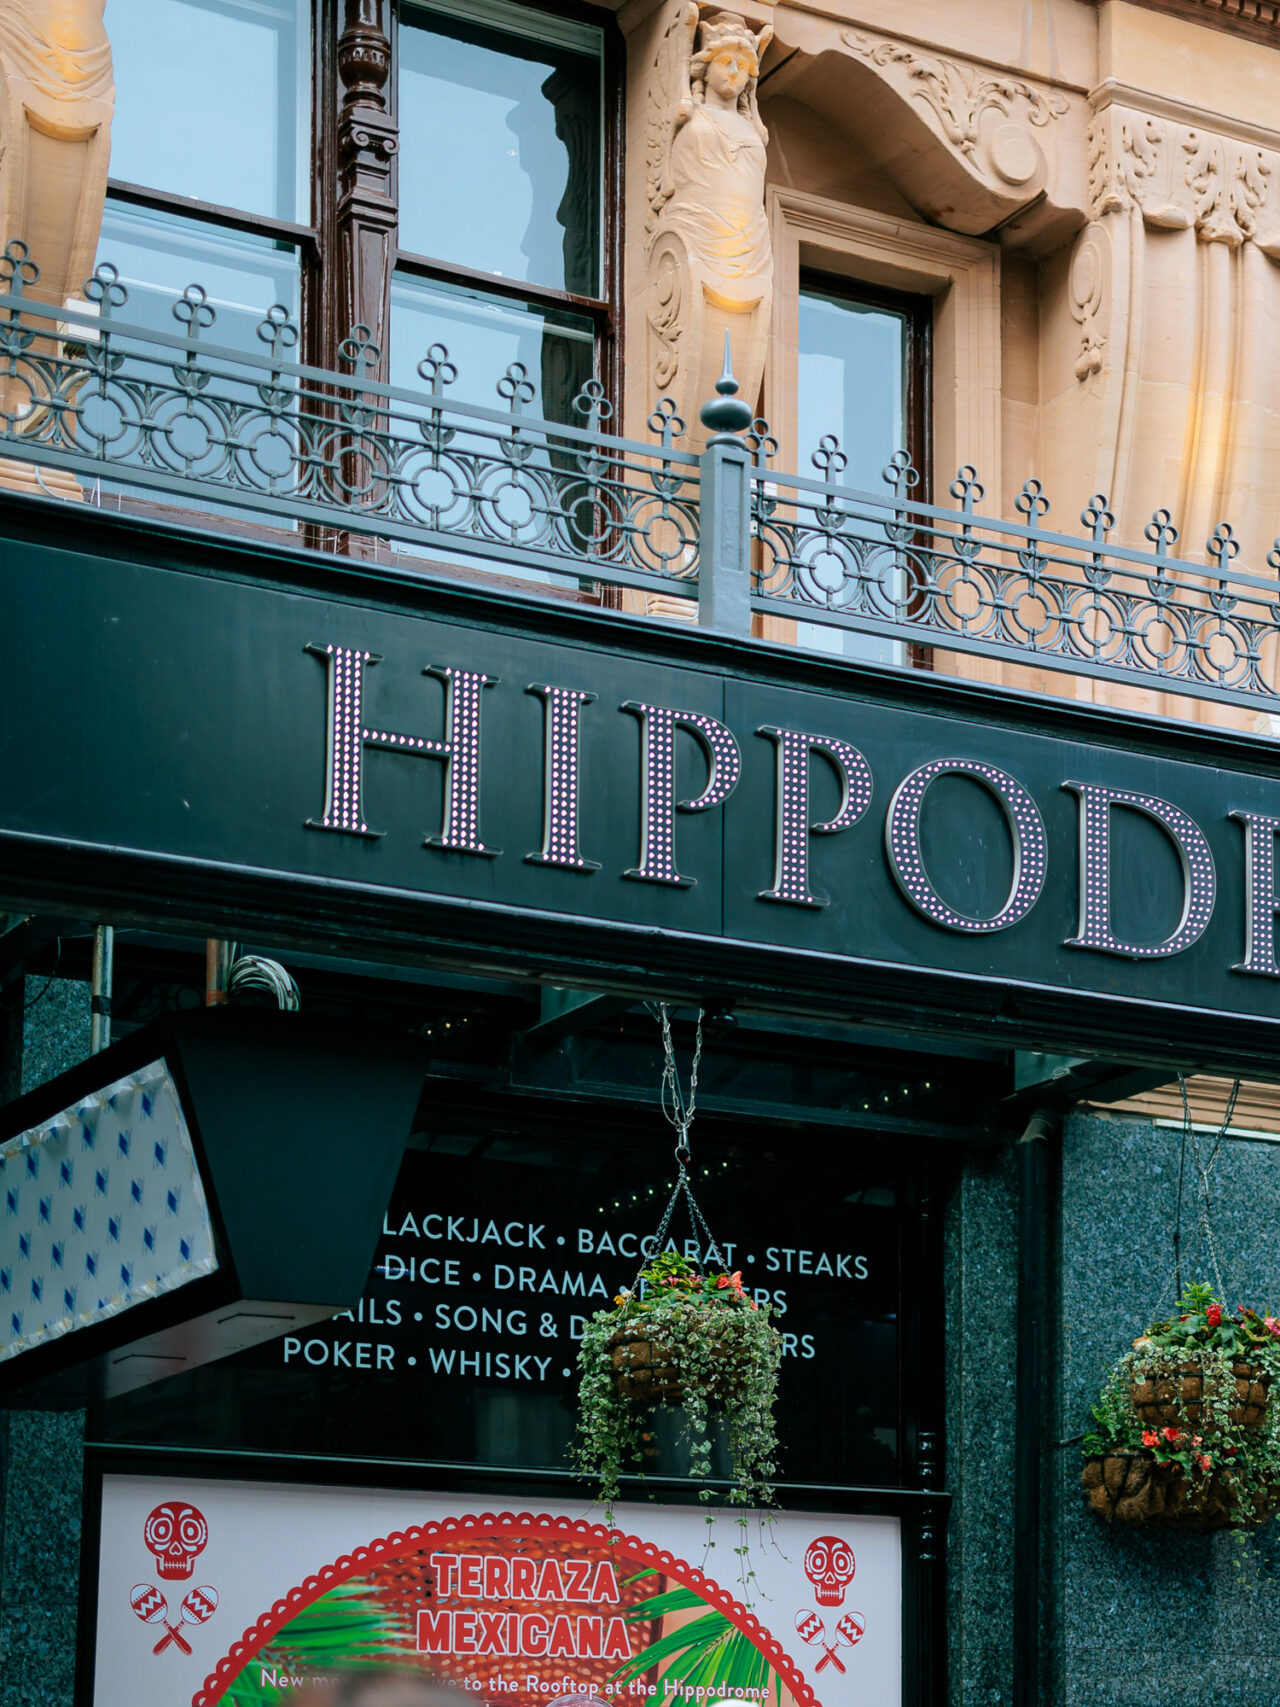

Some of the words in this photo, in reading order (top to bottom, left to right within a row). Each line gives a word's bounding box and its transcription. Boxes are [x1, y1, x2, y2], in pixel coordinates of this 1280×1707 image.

[382, 1211, 546, 1250] LACKJACK
[577, 1228, 737, 1267] BACCARAT
[765, 1247, 869, 1281] STEAKS
[384, 1254, 460, 1286] DICE
[494, 1264, 609, 1299] DRAMA
[435, 1303, 527, 1336] SONG
[538, 1312, 559, 1338] &
[283, 1337, 395, 1370] POKER
[428, 1347, 552, 1382] WHISKY
[430, 1553, 620, 1604] TERRAZA
[416, 1609, 632, 1660] MEXICANA
[260, 1668, 304, 1688] New
[464, 1676, 482, 1691] to
[489, 1674, 519, 1692] the
[526, 1675, 599, 1700] Rooftop
[605, 1681, 622, 1696] at
[629, 1678, 657, 1696] the
[664, 1679, 770, 1702] Hippodrome
